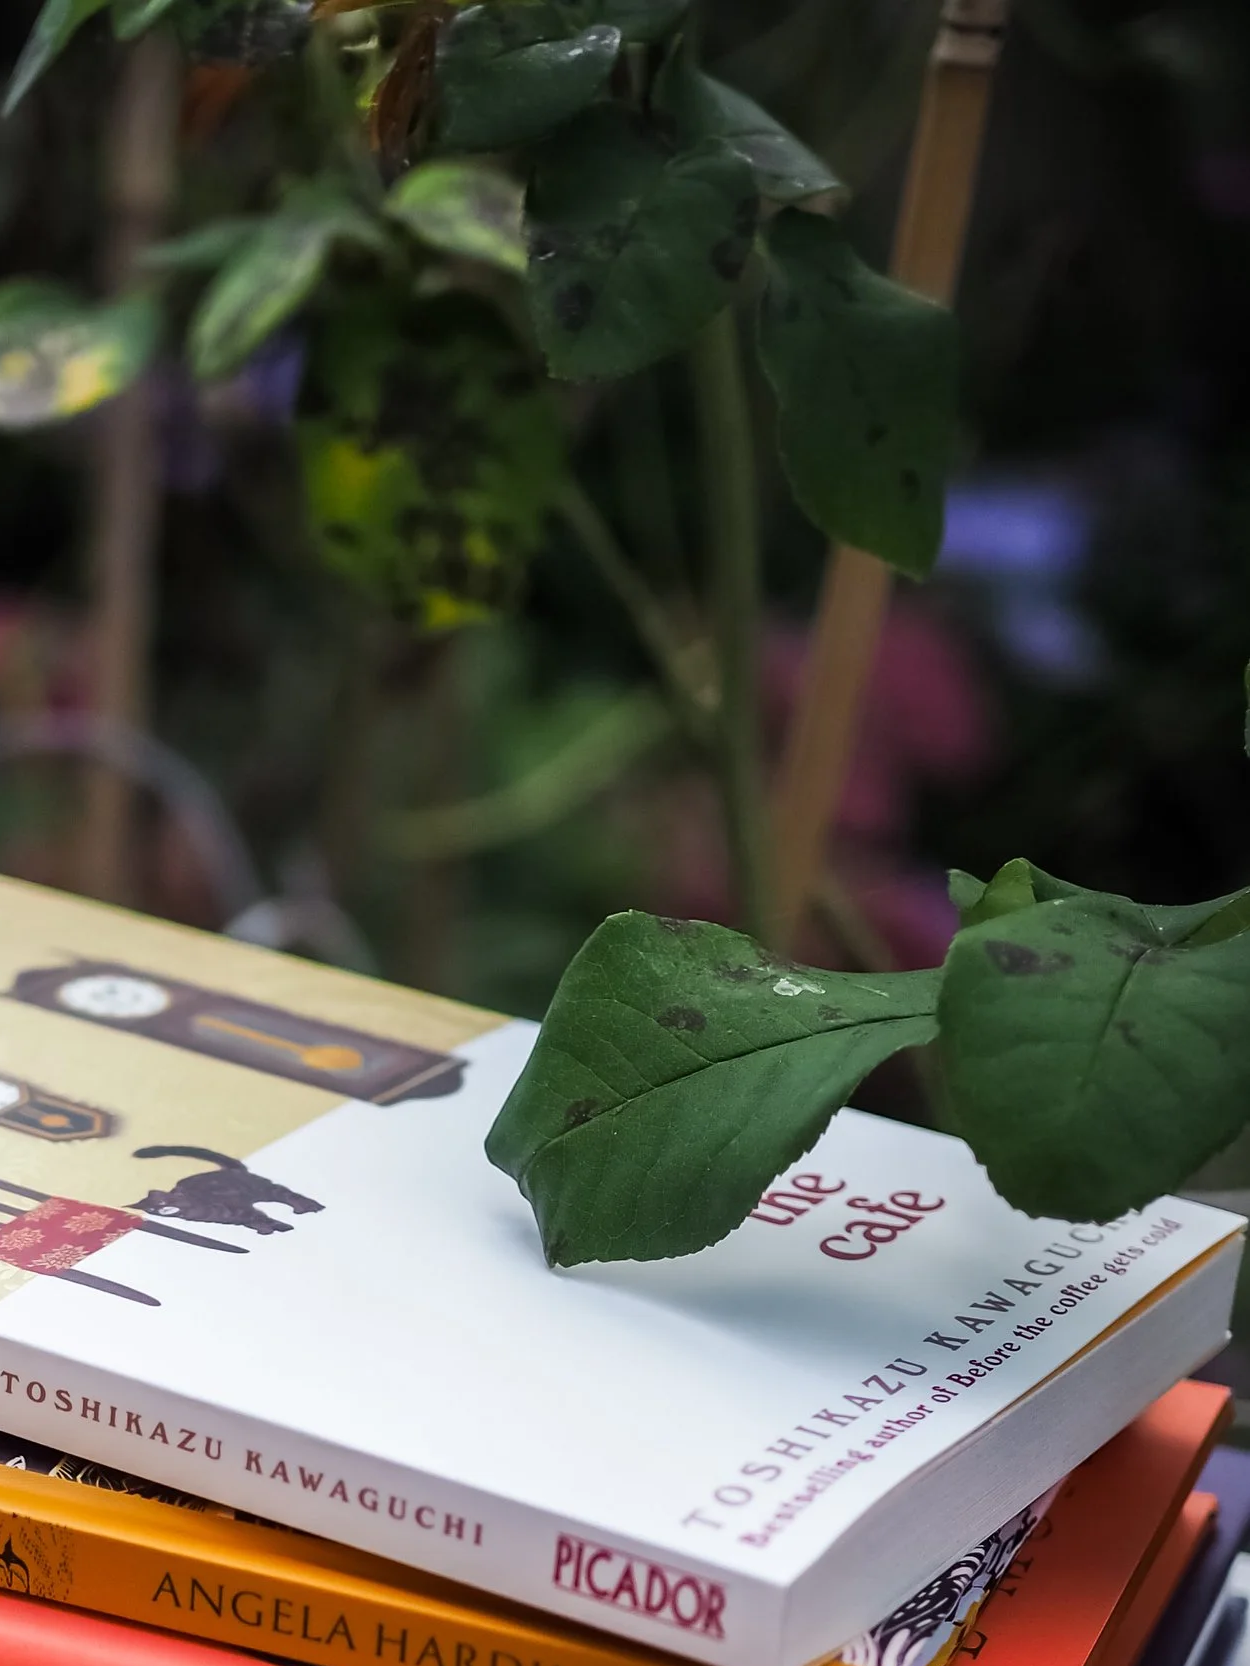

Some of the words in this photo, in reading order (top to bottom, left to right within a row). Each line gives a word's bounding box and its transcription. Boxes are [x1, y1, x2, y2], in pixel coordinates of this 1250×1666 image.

[680, 1357, 928, 1531] TOSHIKAZU
[923, 1217, 1131, 1351] KAWAGUC
[865, 1403, 934, 1448] author
[931, 1385, 959, 1404] of
[946, 1339, 1022, 1388] Before
[1012, 1315, 1054, 1341] the
[1049, 1273, 1108, 1316] coffee
[1103, 1245, 1145, 1276] gets
[1141, 1216, 1183, 1247] cold
[0, 1370, 224, 1460] TOSHIKAZU
[245, 1449, 484, 1547] KAWAGUCHI
[152, 1571, 357, 1652] ANGELA
[553, 1532, 727, 1641] PICADOR
